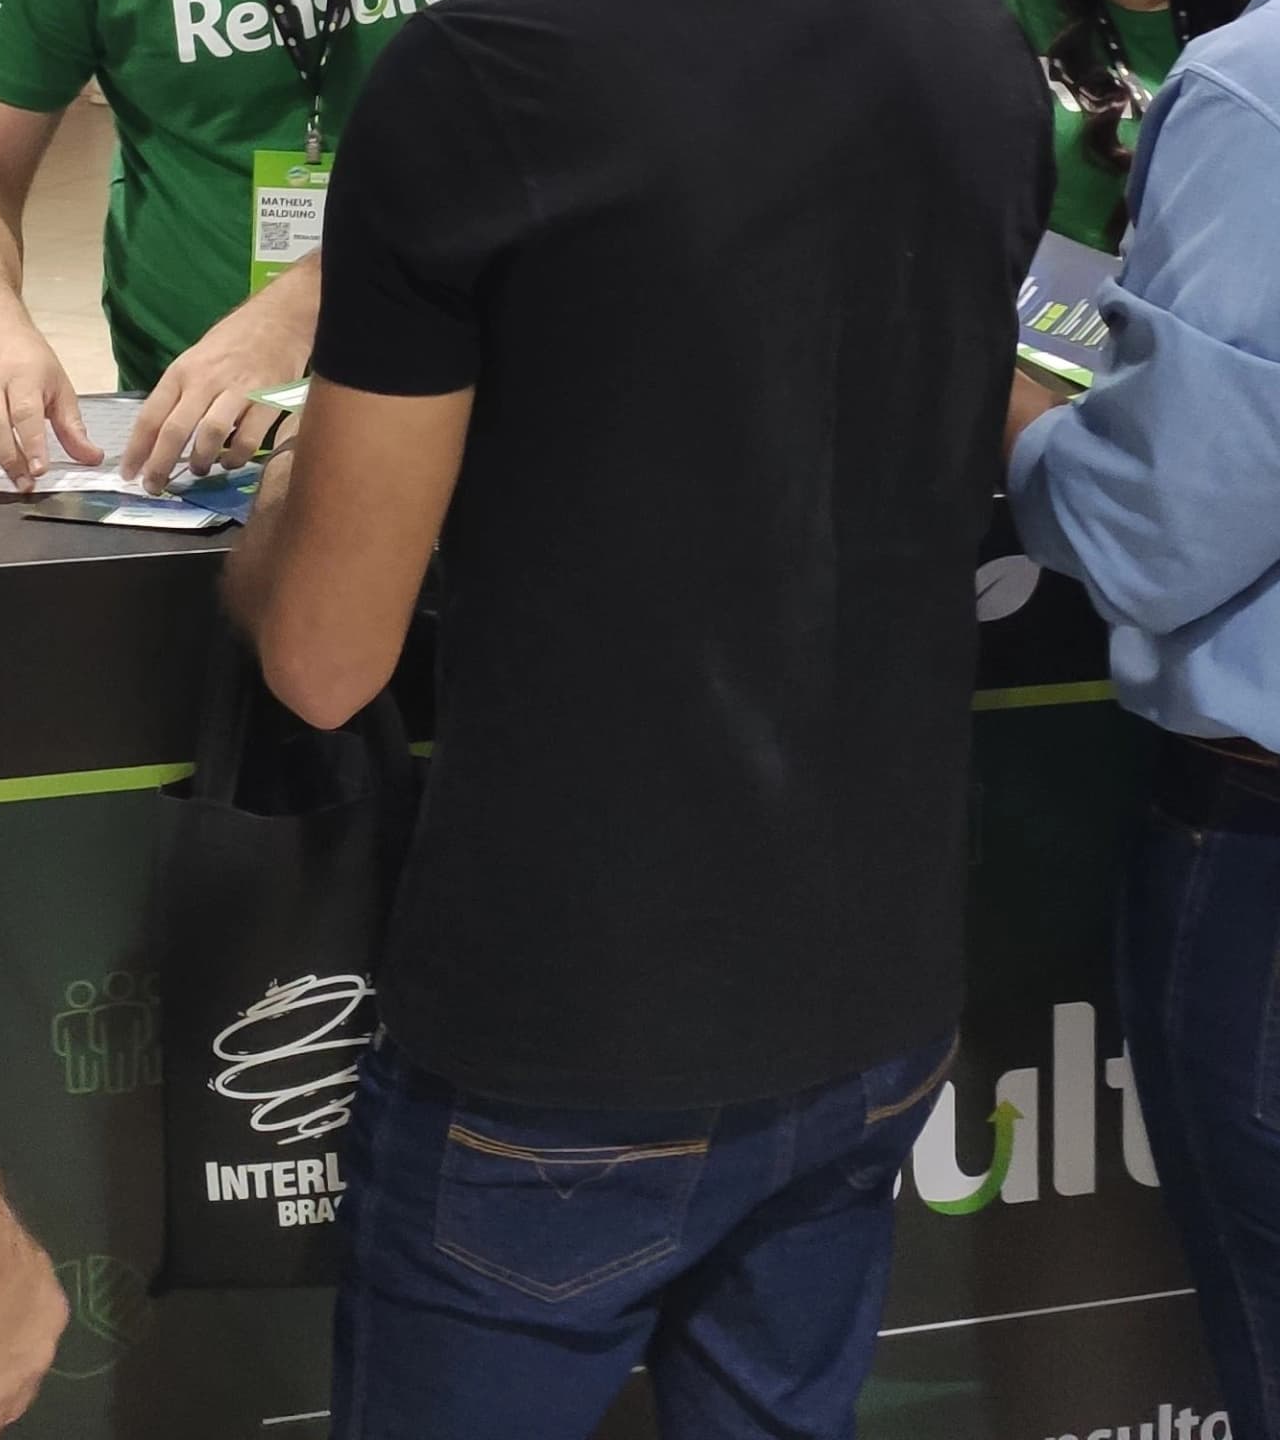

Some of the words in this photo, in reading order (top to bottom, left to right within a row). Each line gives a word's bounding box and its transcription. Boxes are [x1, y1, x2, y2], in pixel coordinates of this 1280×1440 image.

[261, 196, 313, 207] MATHEUS
[261, 208, 316, 219] BALDUINO
[278, 1195, 343, 1228] BRA
